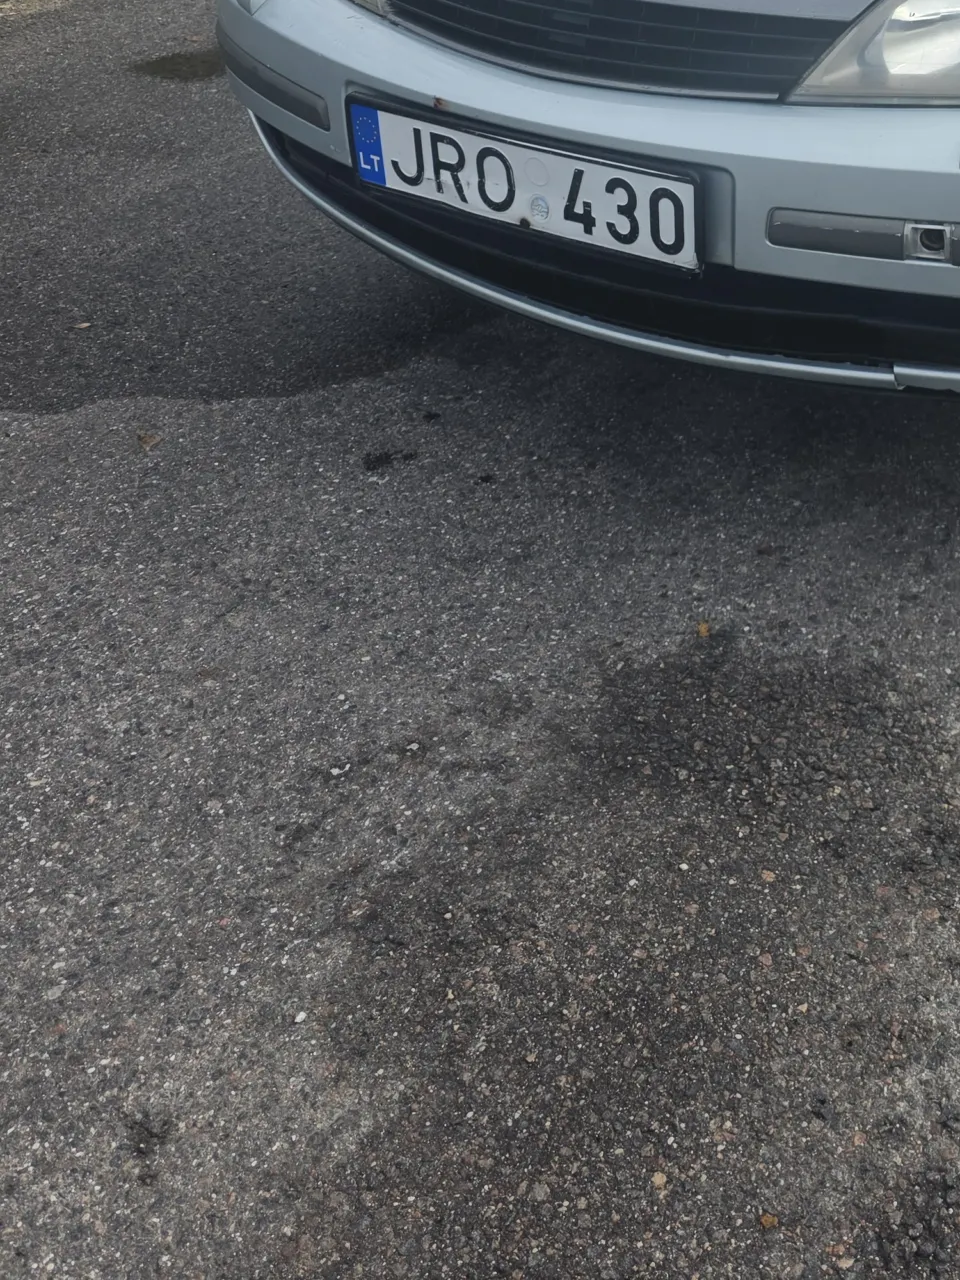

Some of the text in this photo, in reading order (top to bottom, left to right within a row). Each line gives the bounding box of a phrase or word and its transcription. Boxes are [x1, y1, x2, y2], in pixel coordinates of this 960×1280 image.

[359, 151, 380, 172] LT
[391, 127, 685, 255] JRO 430
